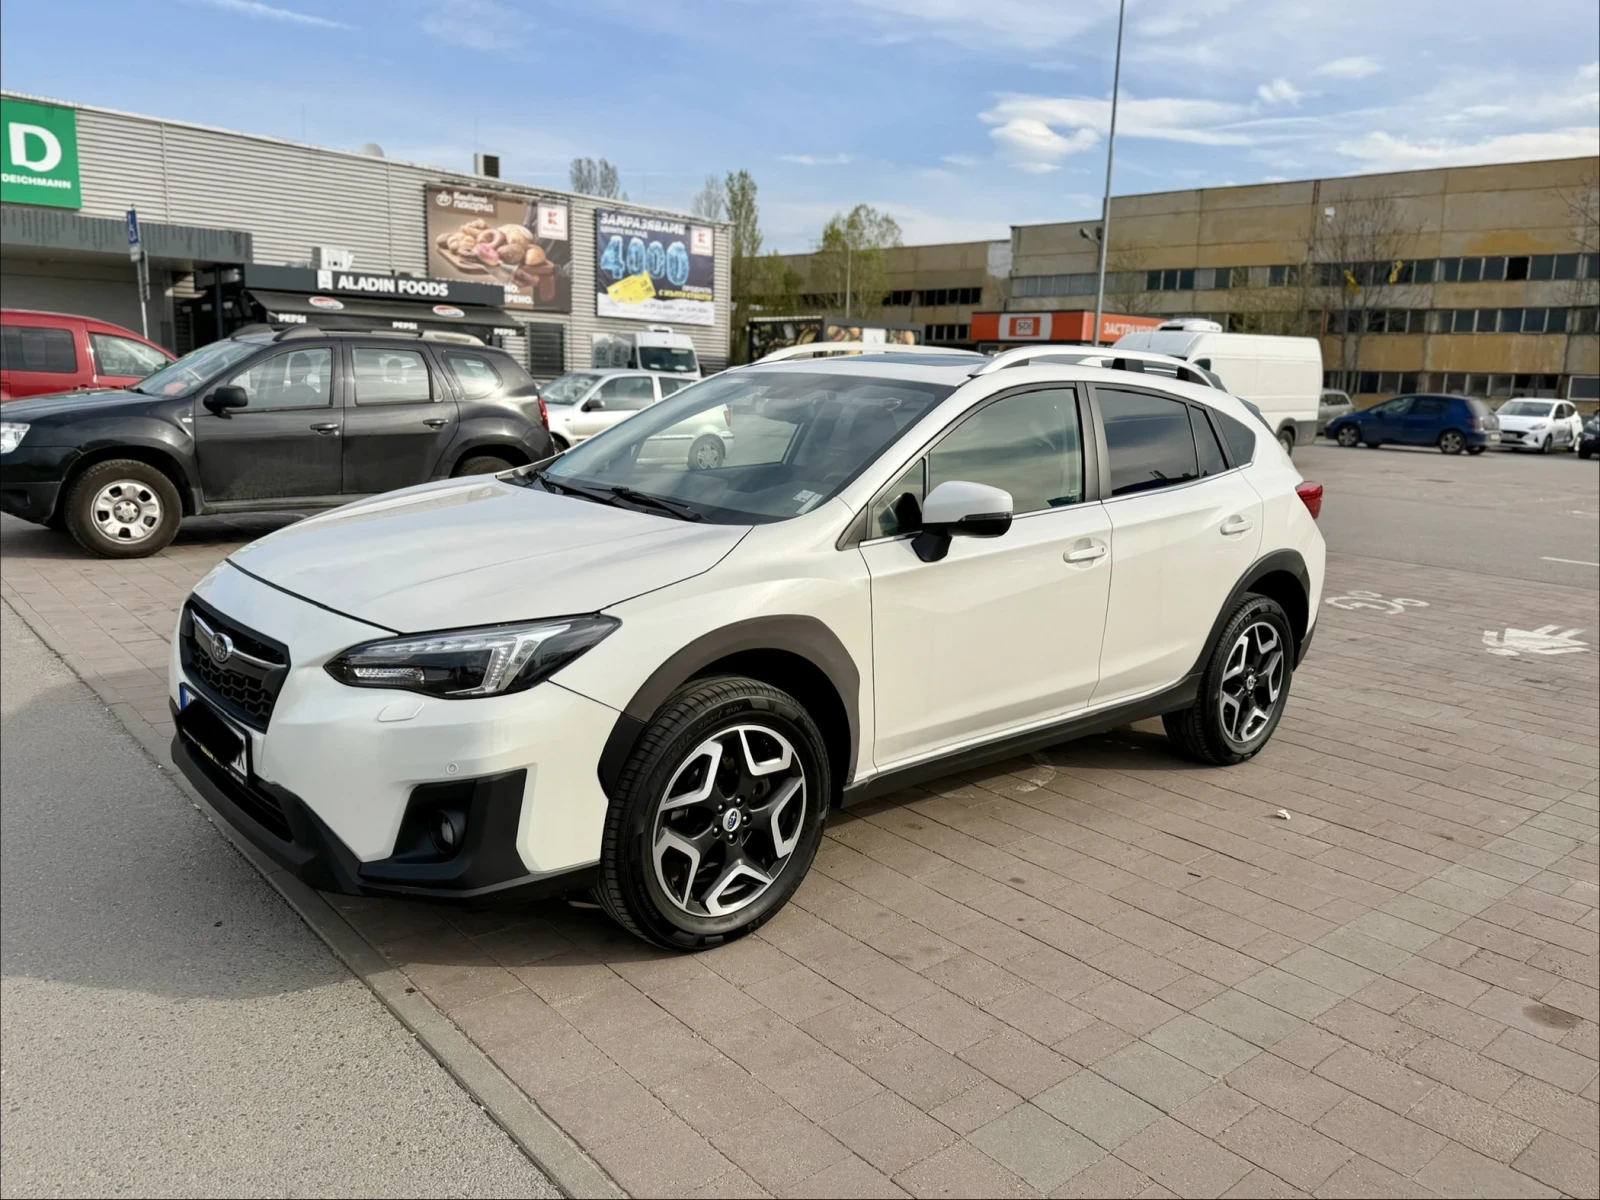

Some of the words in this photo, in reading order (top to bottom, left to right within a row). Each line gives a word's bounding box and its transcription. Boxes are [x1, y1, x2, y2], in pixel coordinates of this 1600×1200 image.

[8, 122, 62, 172] D
[1, 173, 72, 189] DEICHMANN
[601, 213, 685, 235] ЗАМРАЗЯВАМЕ
[600, 235, 690, 286] 4000
[337, 275, 395, 293] ALADIN
[398, 279, 449, 297] FOODS
[278, 313, 307, 324] PEPSI
[392, 321, 418, 330] PEPSI
[493, 328, 517, 337] PEPSI
